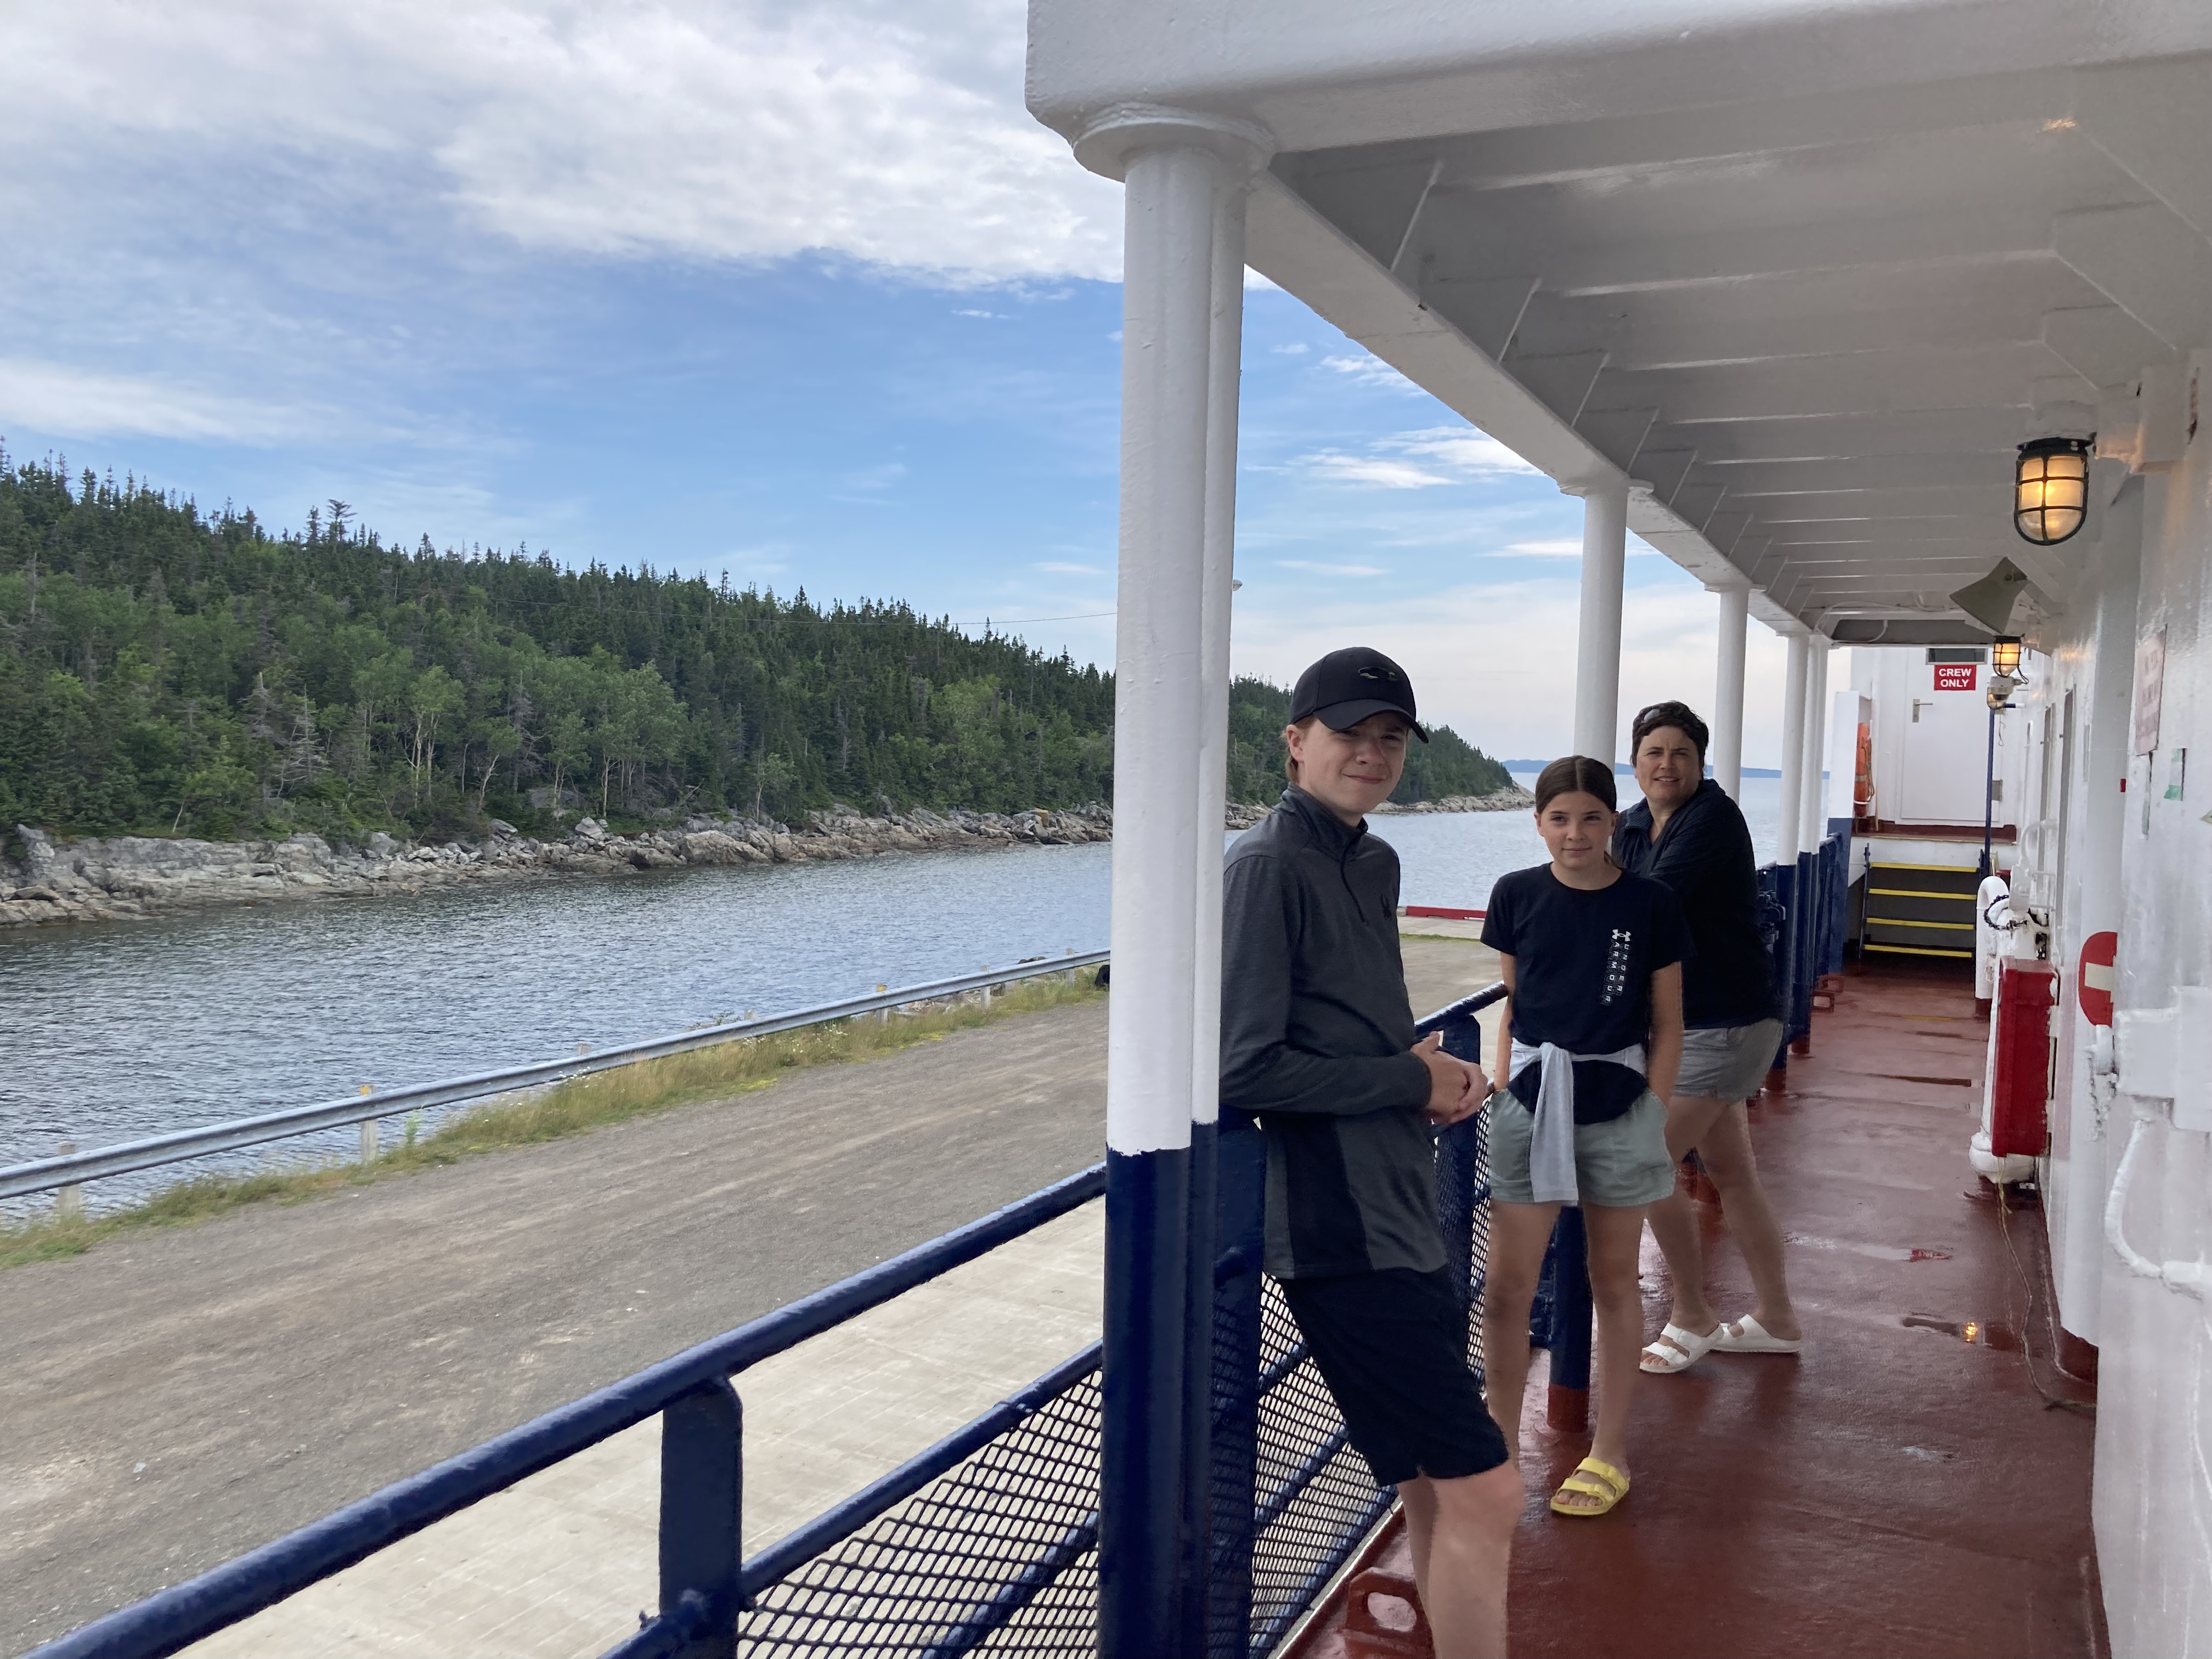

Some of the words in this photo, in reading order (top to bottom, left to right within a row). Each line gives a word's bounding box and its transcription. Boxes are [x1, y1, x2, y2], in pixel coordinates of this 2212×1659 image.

[1938, 668, 1972, 677] CREW
[1940, 679, 1970, 688] ONLY
[1604, 941, 1620, 1003] ARMOUR
[1616, 944, 1630, 992] UNDER
